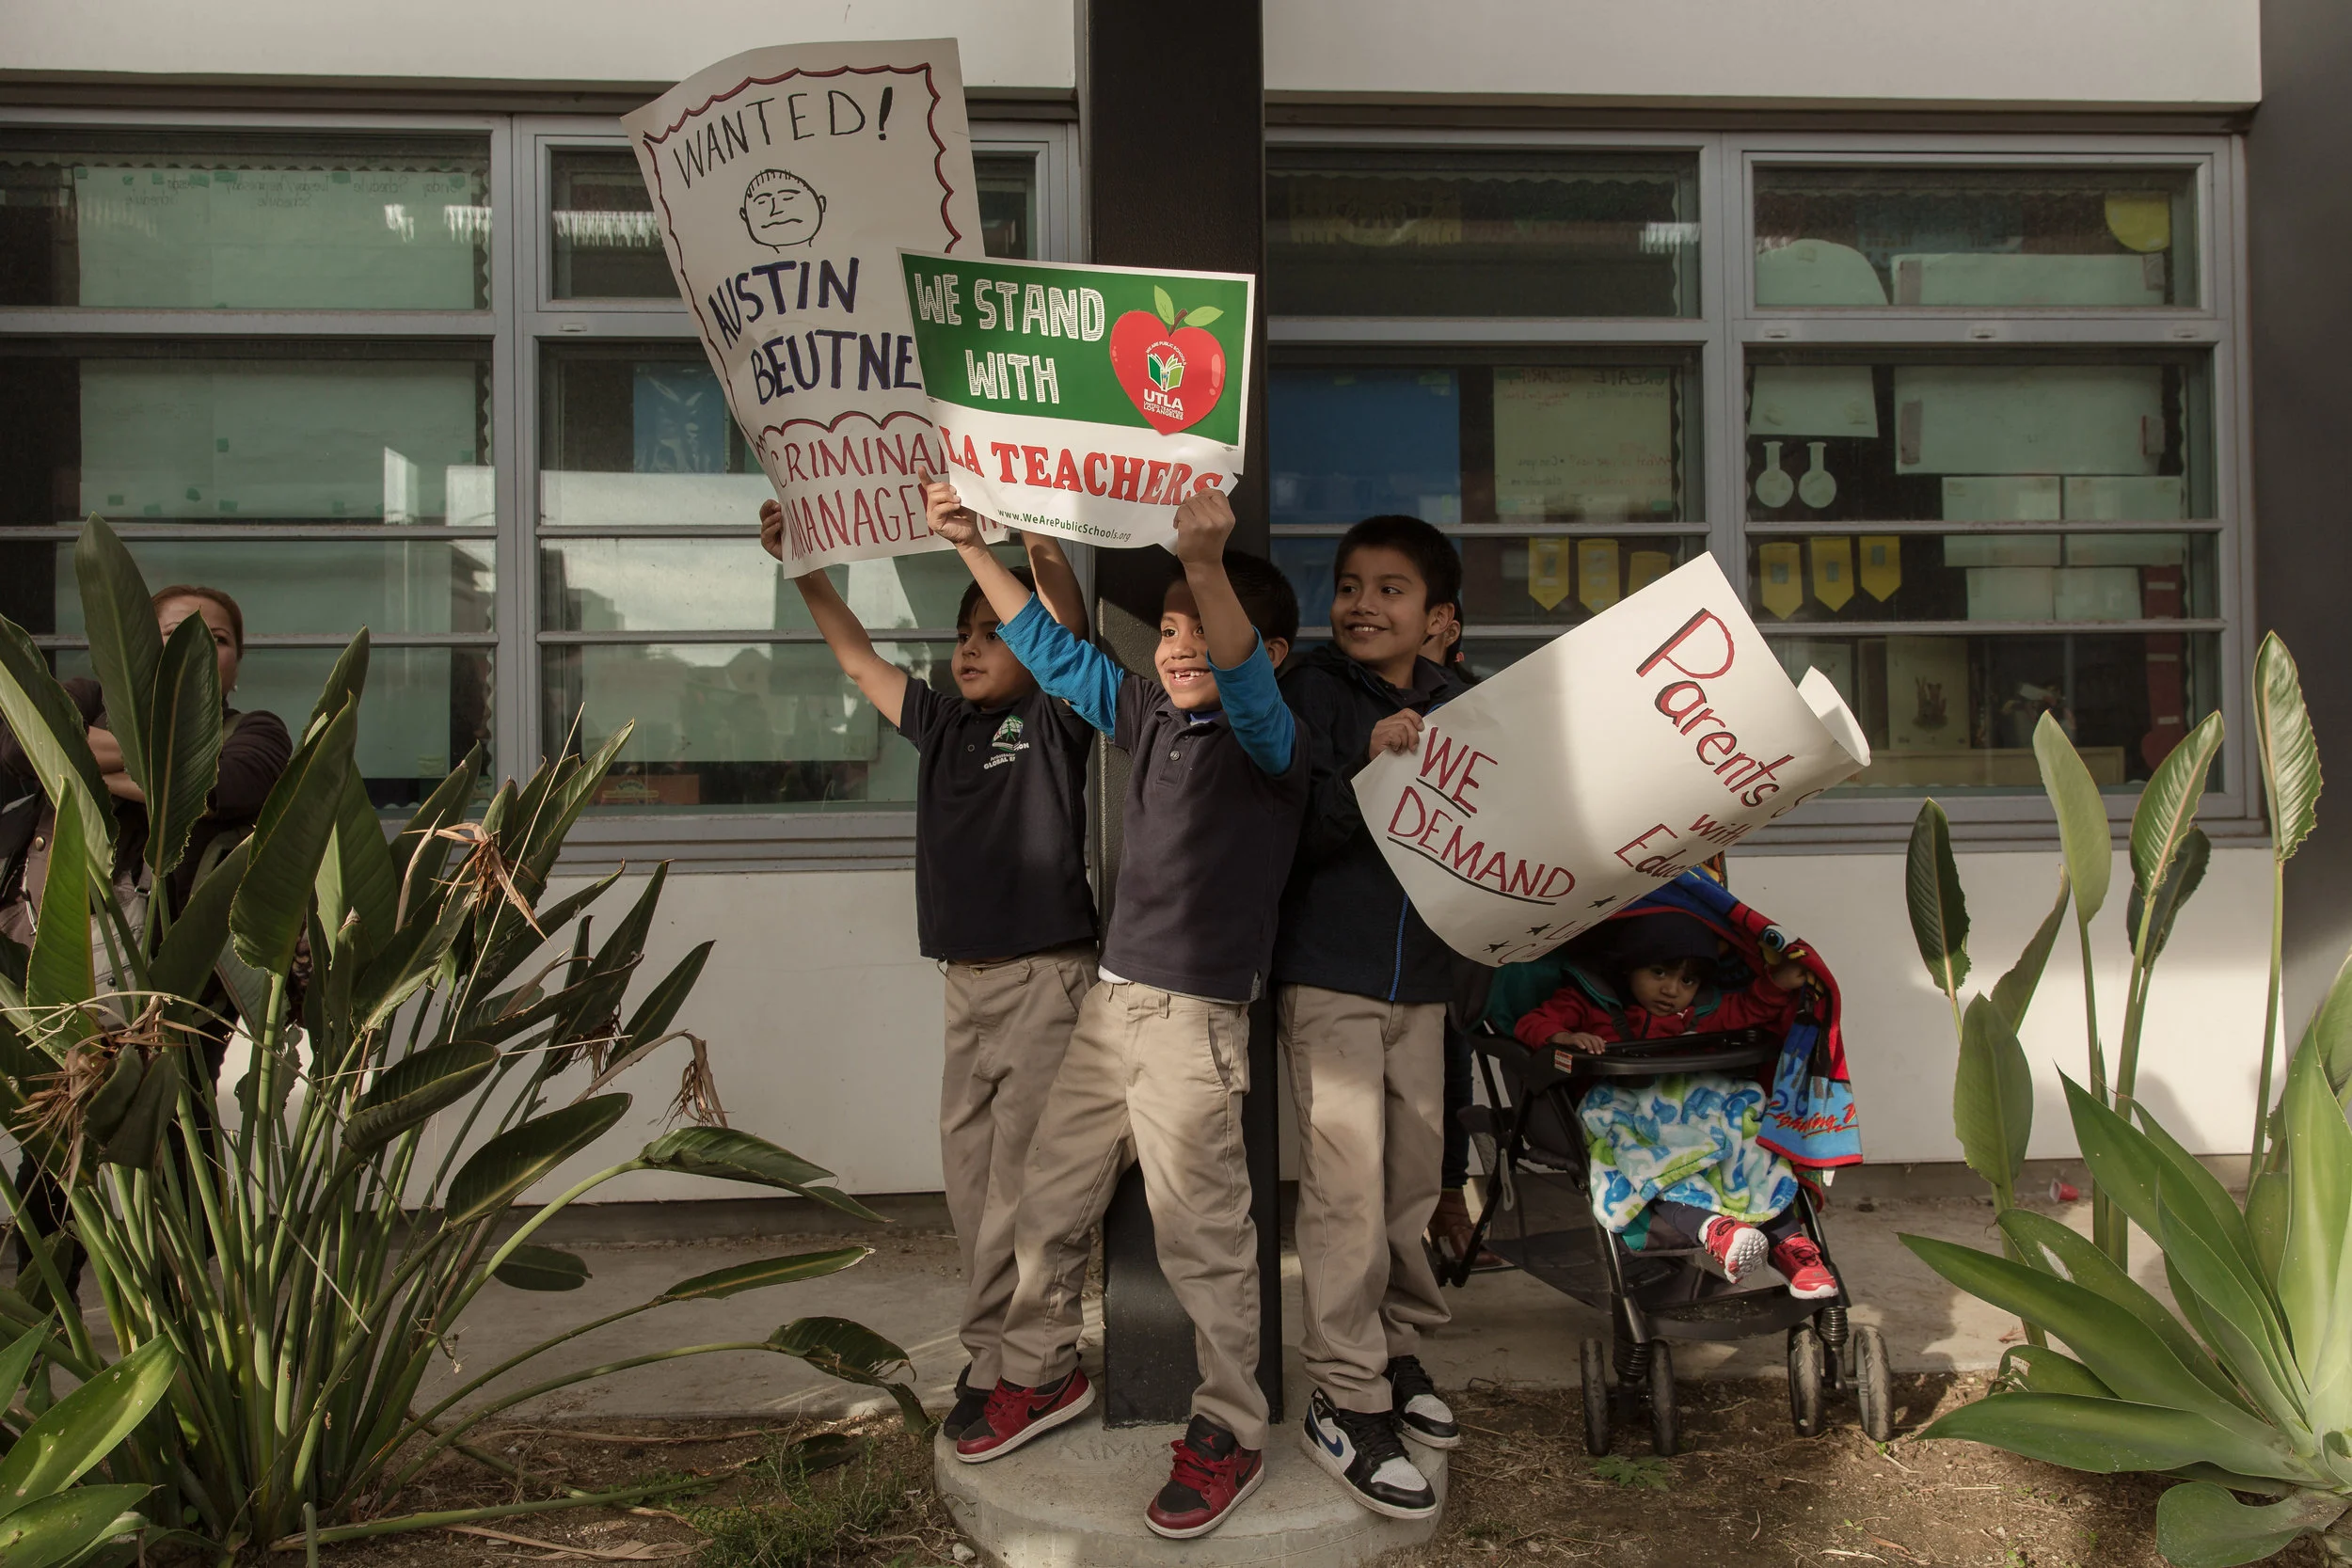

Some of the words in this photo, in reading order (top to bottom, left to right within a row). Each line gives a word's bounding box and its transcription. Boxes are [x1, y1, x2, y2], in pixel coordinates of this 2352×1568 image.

[673, 87, 894, 189] WANTED!
[707, 257, 859, 349] AUSTIN
[914, 273, 962, 325] WE
[974, 278, 1105, 341] STAND
[750, 329, 923, 405] BEUTNE
[964, 349, 1060, 404] WITH
[1151, 341, 1159, 349] ARE
[1173, 345, 1187, 366] SCHOOLS
[1144, 388, 1184, 412] UTLA
[1144, 404, 1155, 412] LOS
[1155, 408, 1184, 420] ANGELES
[771, 433, 949, 488] CRIMINAL
[939, 425, 984, 478] LA
[991, 441, 1224, 506] TEACHERS
[997, 509, 1132, 542] www.WeArePublicSchools.org
[1636, 607, 1794, 808] Parents
[983, 756, 1009, 769] GLOBAL
[1419, 726, 1498, 815] WE
[1387, 785, 1576, 899] DEMAND
